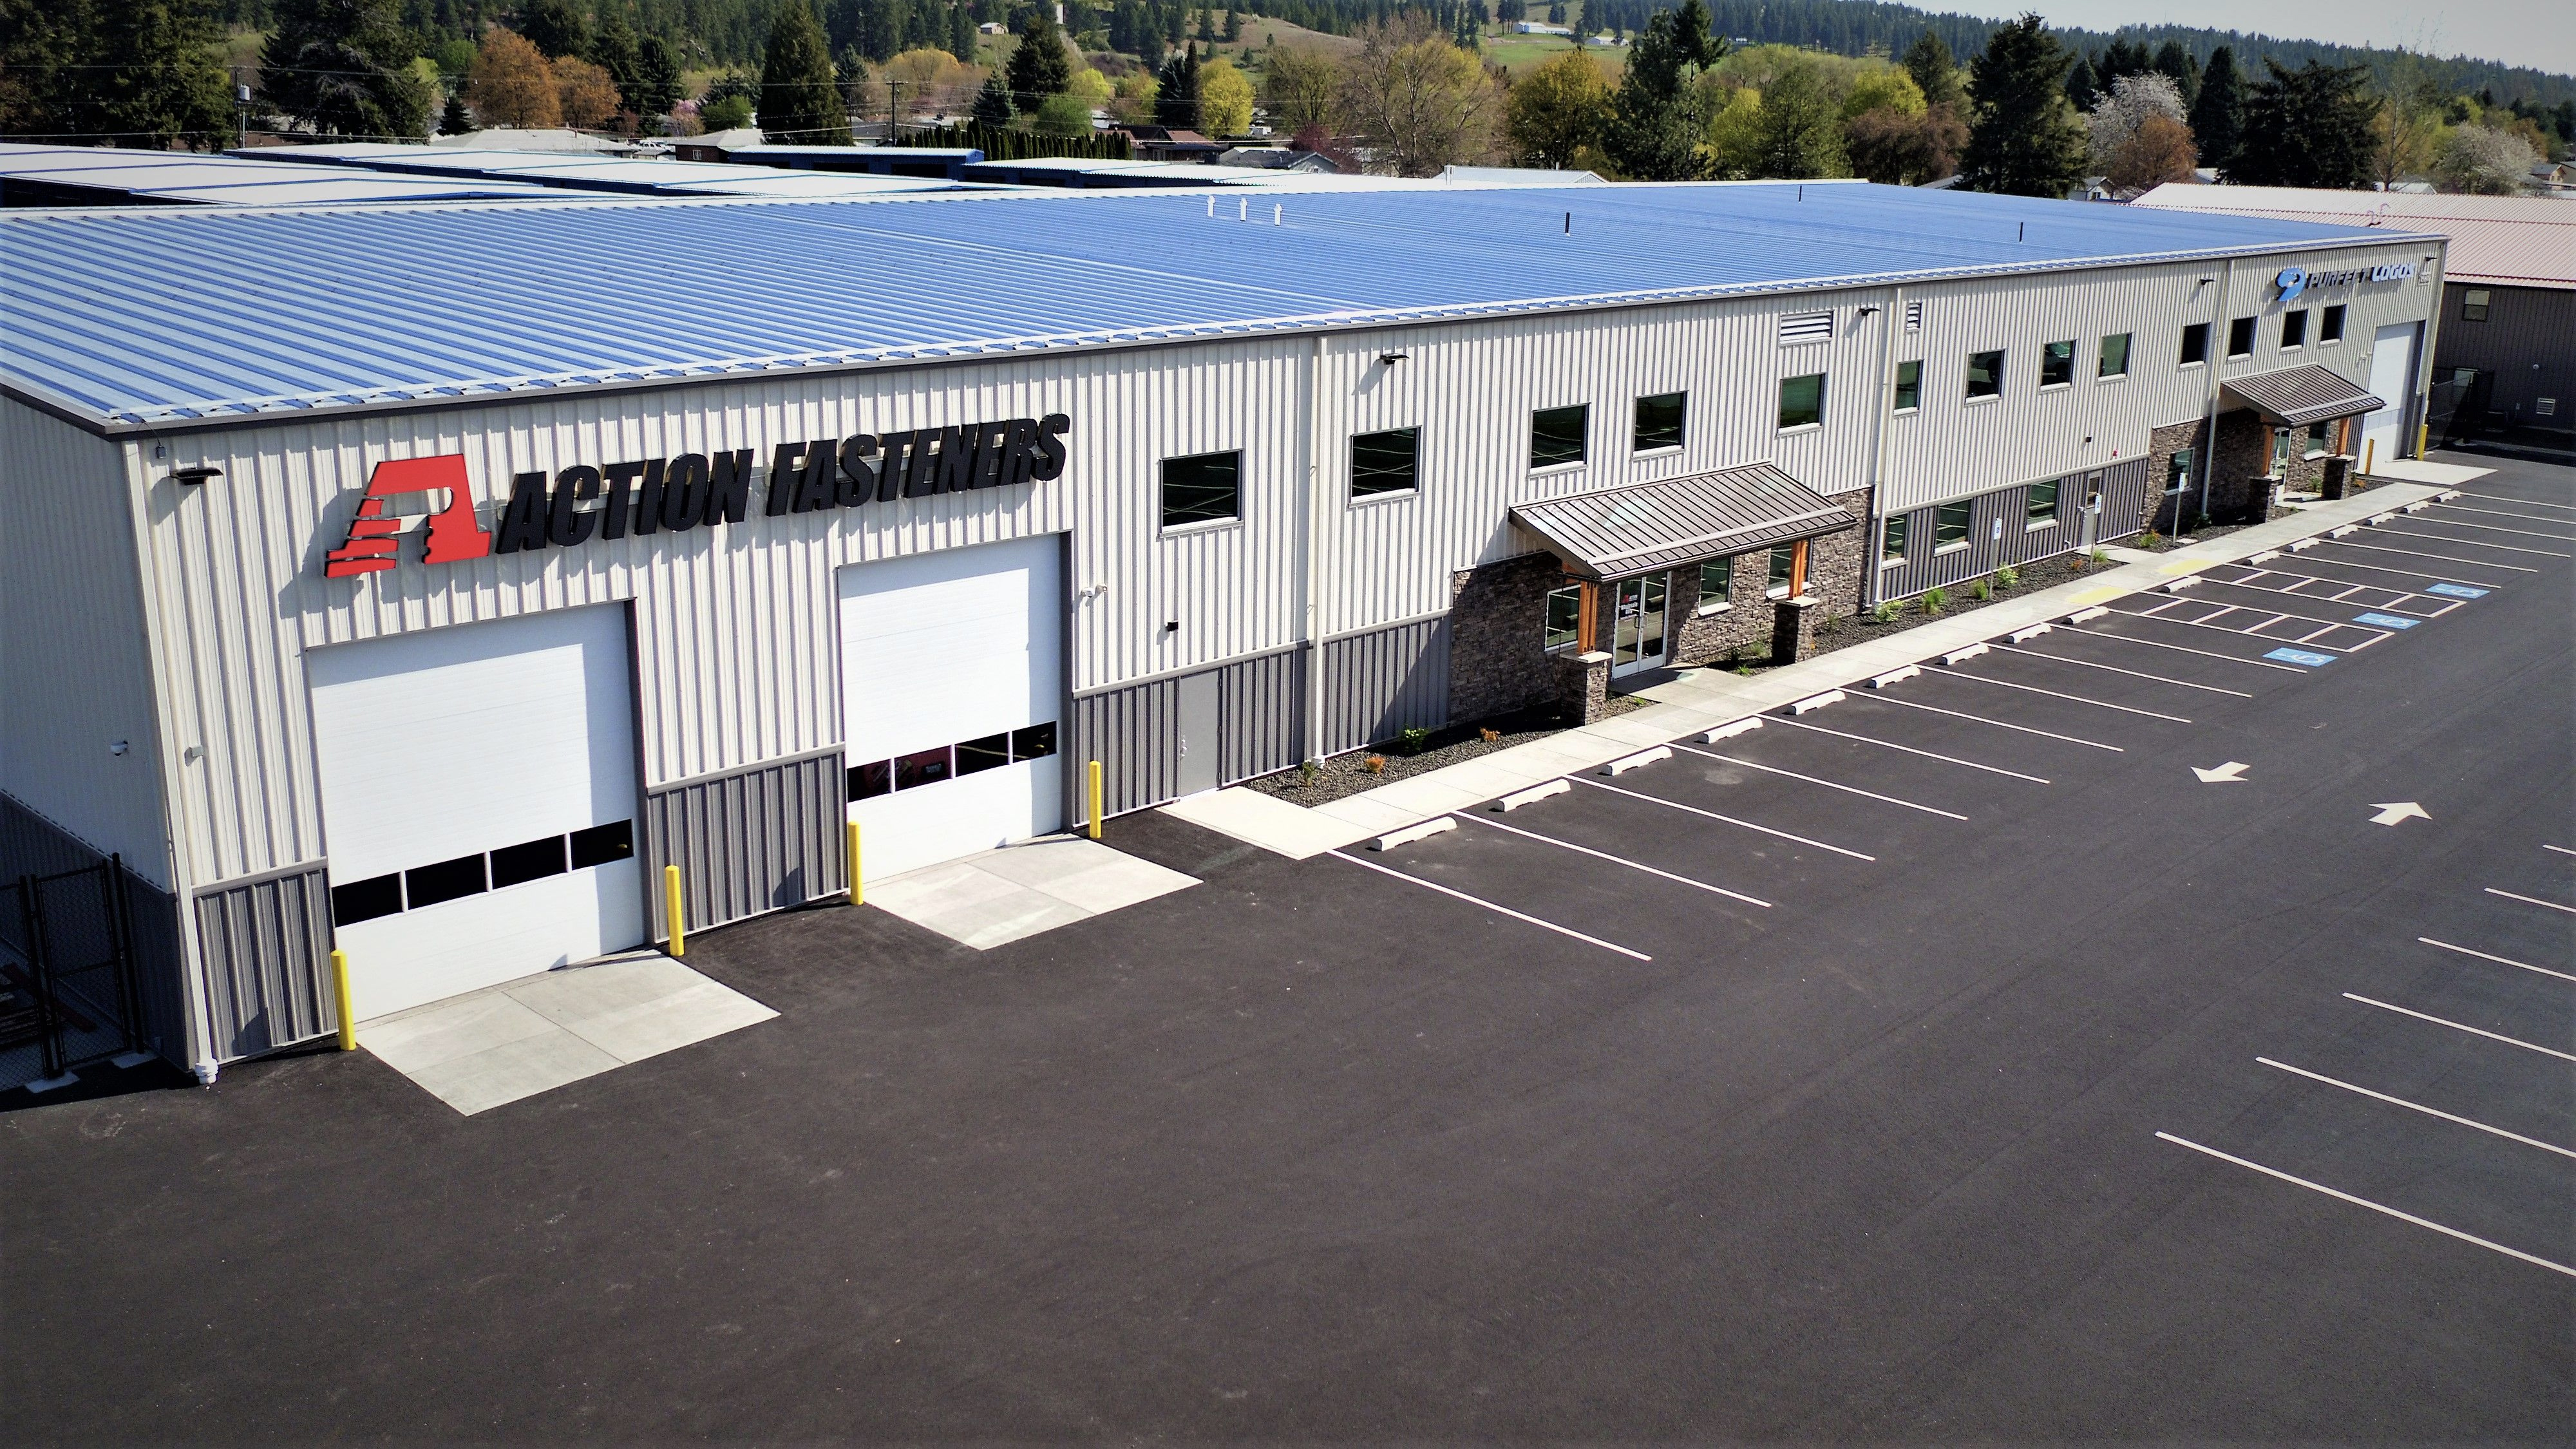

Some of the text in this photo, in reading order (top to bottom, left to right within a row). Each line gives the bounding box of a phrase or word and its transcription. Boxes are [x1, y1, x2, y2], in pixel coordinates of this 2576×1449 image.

[2372, 263, 2416, 281] LOGOS
[495, 448, 754, 554] ACTION
[766, 413, 1070, 516] FASTENERS
